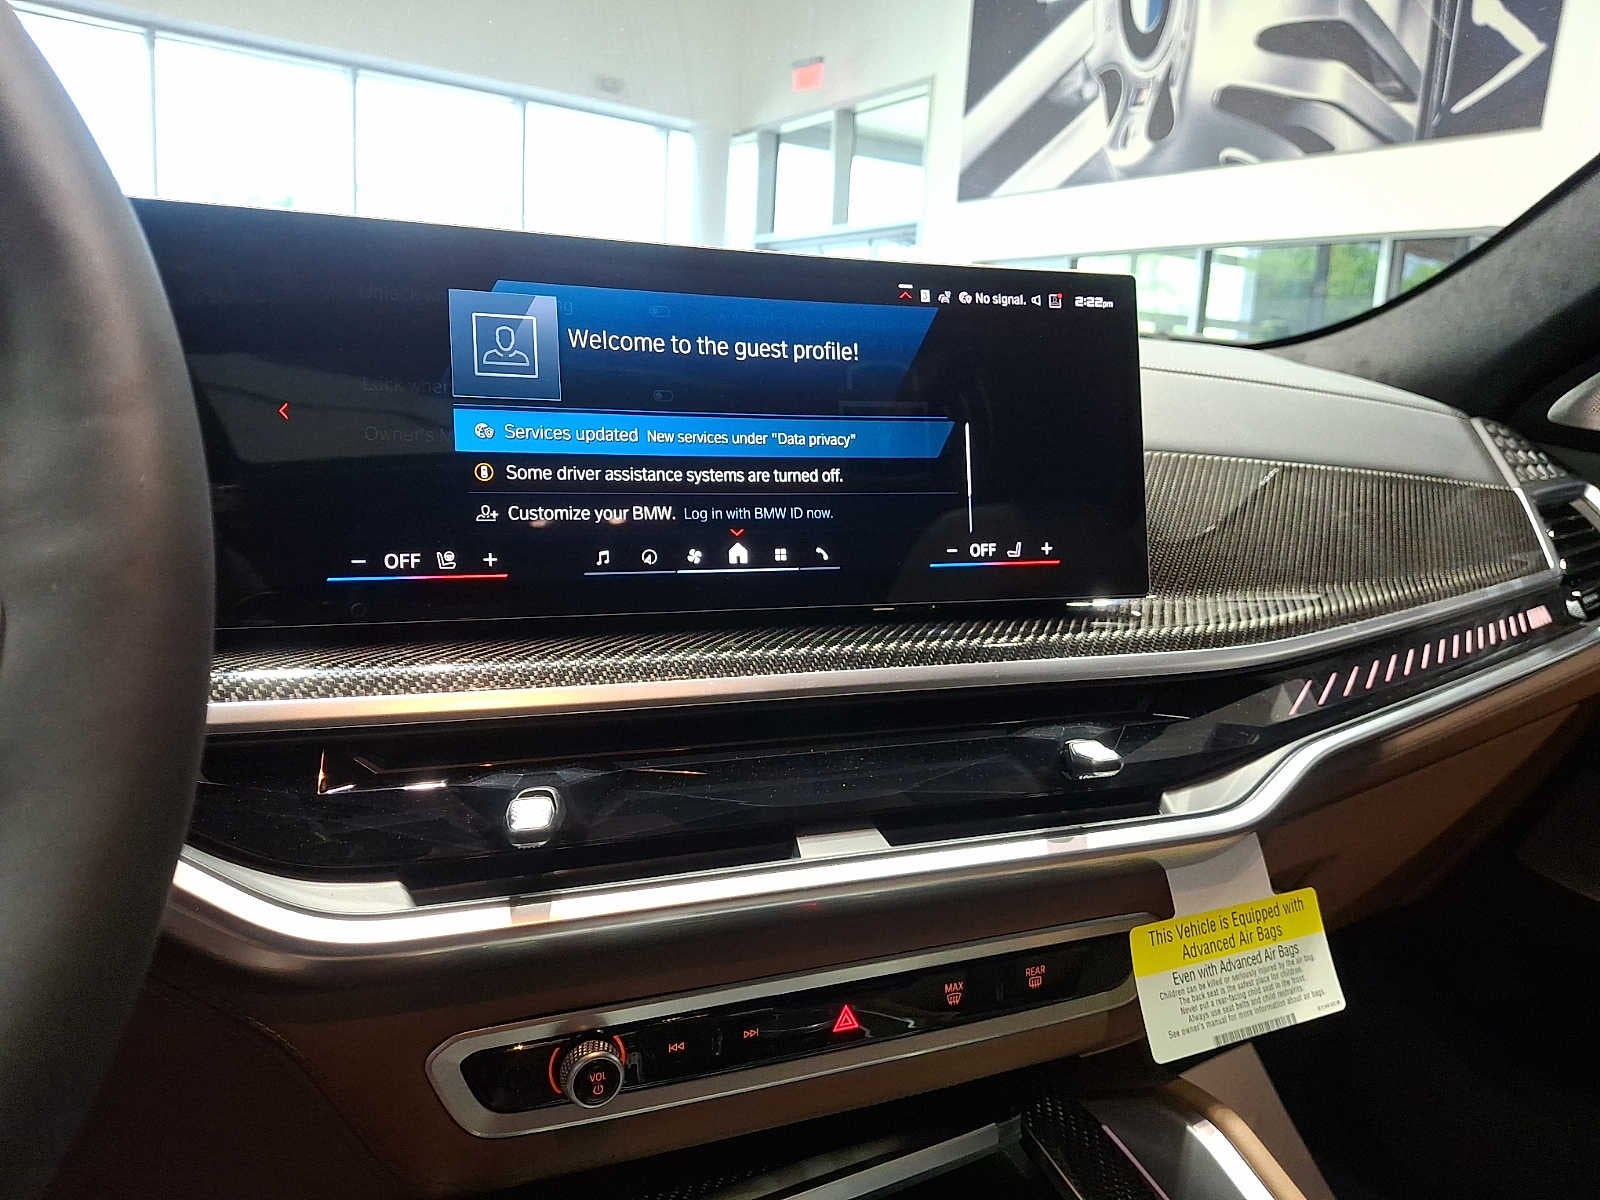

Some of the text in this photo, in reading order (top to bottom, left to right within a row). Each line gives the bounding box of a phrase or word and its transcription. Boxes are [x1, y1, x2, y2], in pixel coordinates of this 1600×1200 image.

[976, 292, 1026, 307] No signal.
[1075, 296, 1113, 309] 2:22pm
[568, 328, 858, 363] Welcome to the guest profile!
[504, 424, 856, 449] Services updated New services under "Data privacy"
[506, 465, 843, 485] Some driver assistance systems are turned off.
[508, 505, 676, 524] Customize your BMW.
[684, 507, 833, 522] Log in with BMW ID now.
[969, 543, 996, 558] OFF
[384, 553, 421, 569] OFF
[1148, 897, 1304, 947] This Vehicle is Equipped with
[1182, 922, 1283, 960] Advanced Air Bags
[1025, 965, 1046, 977] REAR
[1172, 943, 1300, 986] Even with Advanced Air Bags
[944, 981, 964, 992] MAX
[589, 1072, 606, 1082] VOL
